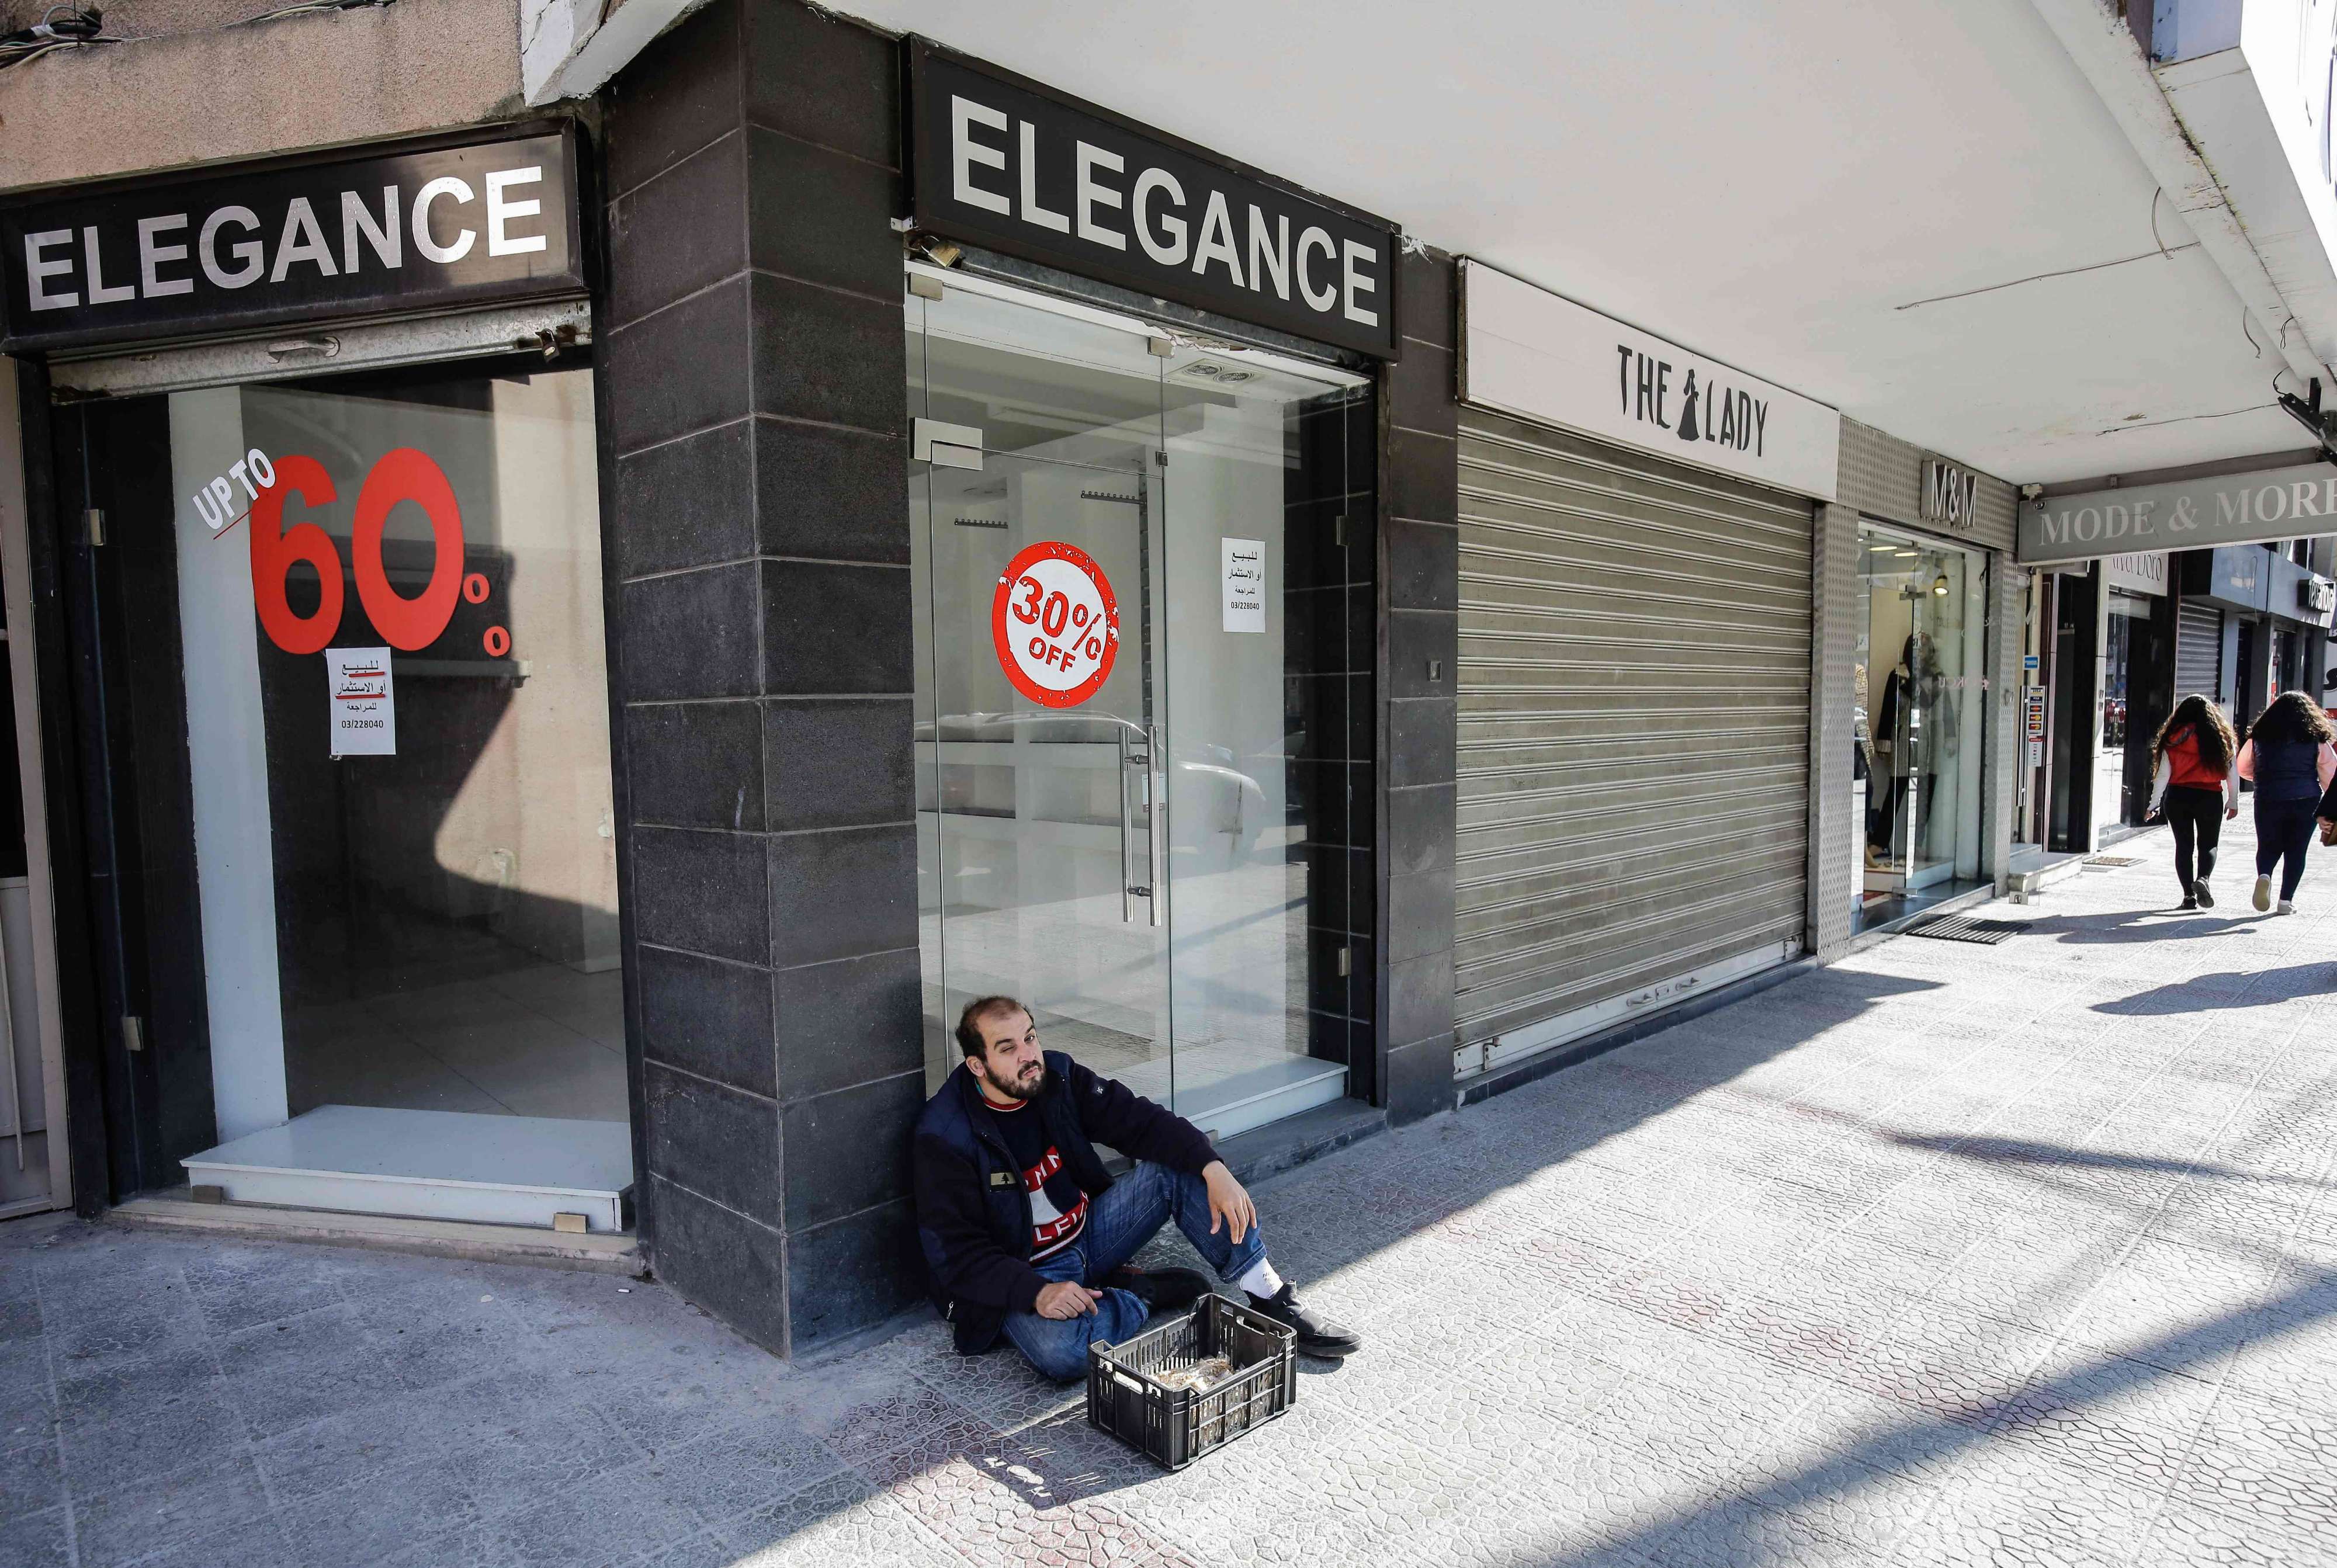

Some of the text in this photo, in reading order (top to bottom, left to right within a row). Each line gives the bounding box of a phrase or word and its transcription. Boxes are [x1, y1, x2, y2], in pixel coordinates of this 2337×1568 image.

[952, 94, 1379, 327] ELEGANCE
[24, 165, 547, 311] ELEGANCE
[1618, 345, 1769, 457] THE LADY
[192, 448, 276, 529] UP TO
[1930, 460, 1977, 527] M&M
[2038, 500, 2155, 546] MODE
[2168, 496, 2200, 532] &
[1232, 551, 1257, 562] للبيع
[1013, 576, 1102, 660] 30%
[1230, 601, 1260, 610] 03/228040
[341, 660, 379, 675] للبيع
[1029, 637, 1076, 672] OFF
[337, 681, 373, 695] الاستثمار
[346, 702, 377, 712] للمراجعة
[341, 719, 384, 729] 03/228040
